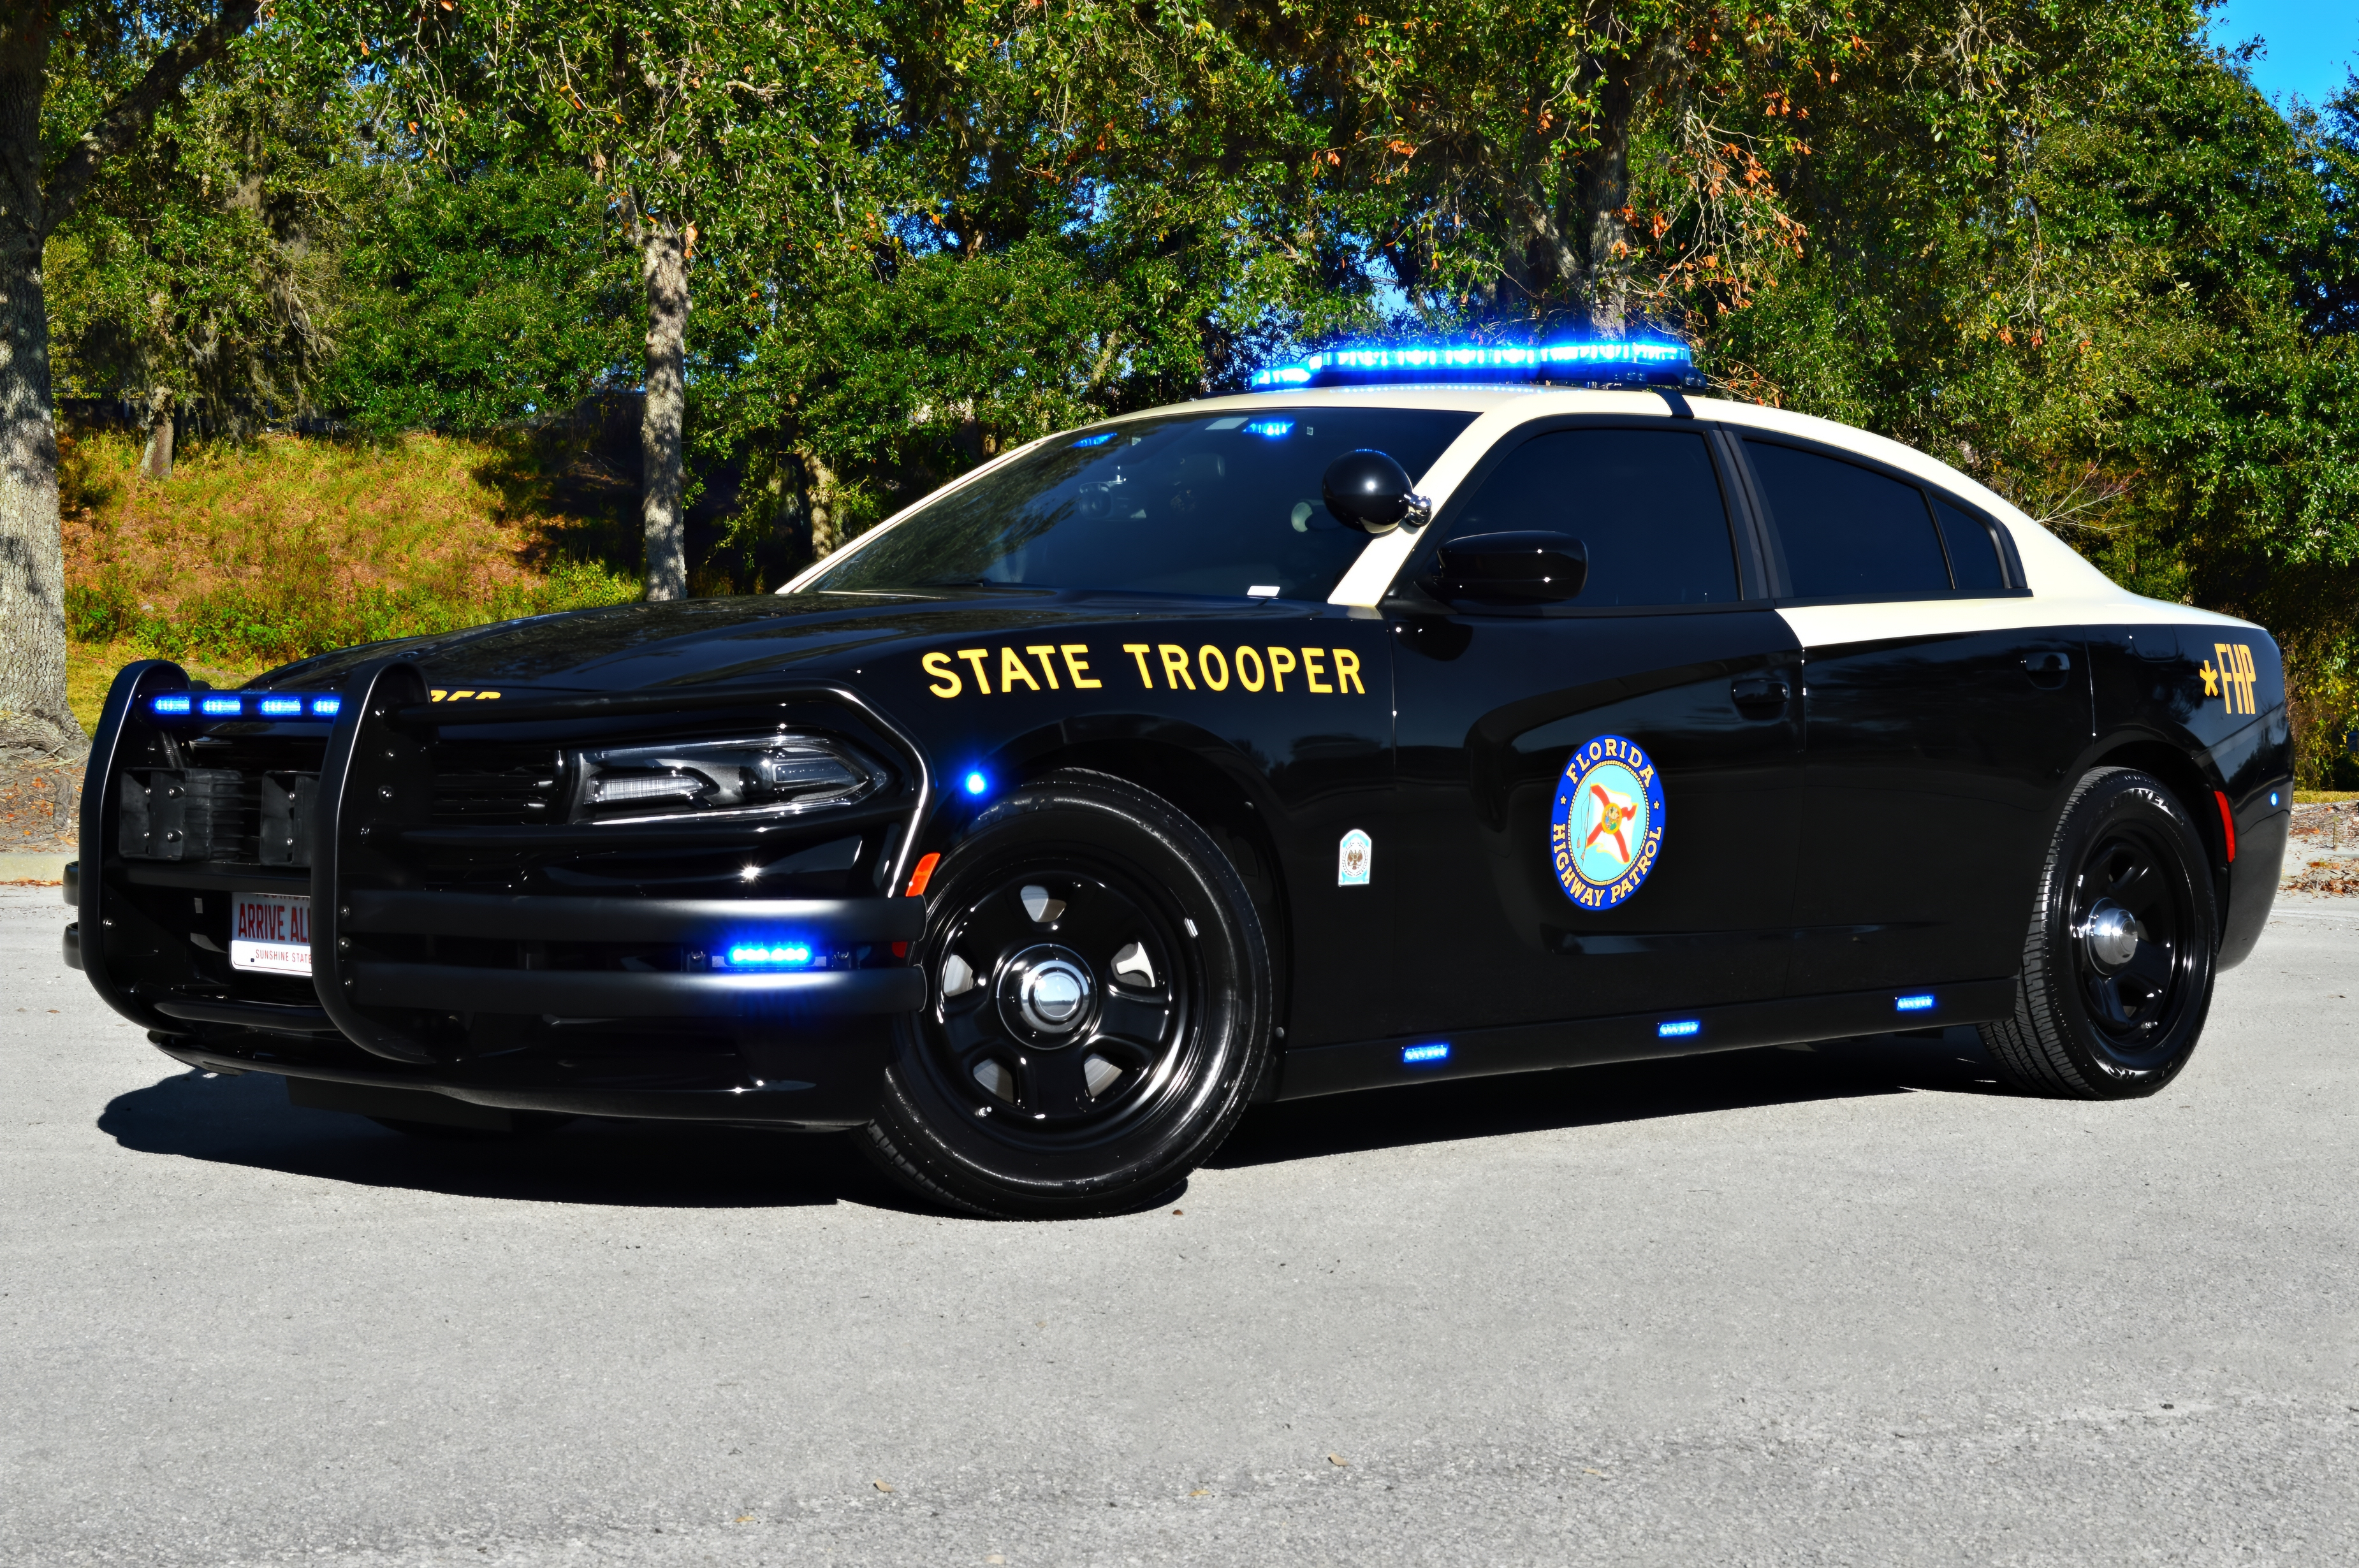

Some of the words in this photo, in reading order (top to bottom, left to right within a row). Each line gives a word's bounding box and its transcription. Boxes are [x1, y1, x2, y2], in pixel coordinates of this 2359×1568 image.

[922, 644, 1102, 699] STATE
[1123, 644, 1366, 694] TROOPER
[1565, 737, 1656, 788] FLORIDA
[1552, 823, 1606, 908] HIGHWAY
[1610, 826, 1662, 904] PATROL
[238, 903, 286, 941] ARRIVE
[256, 948, 289, 962] SUNSHINE
[292, 952, 312, 964] STATE
